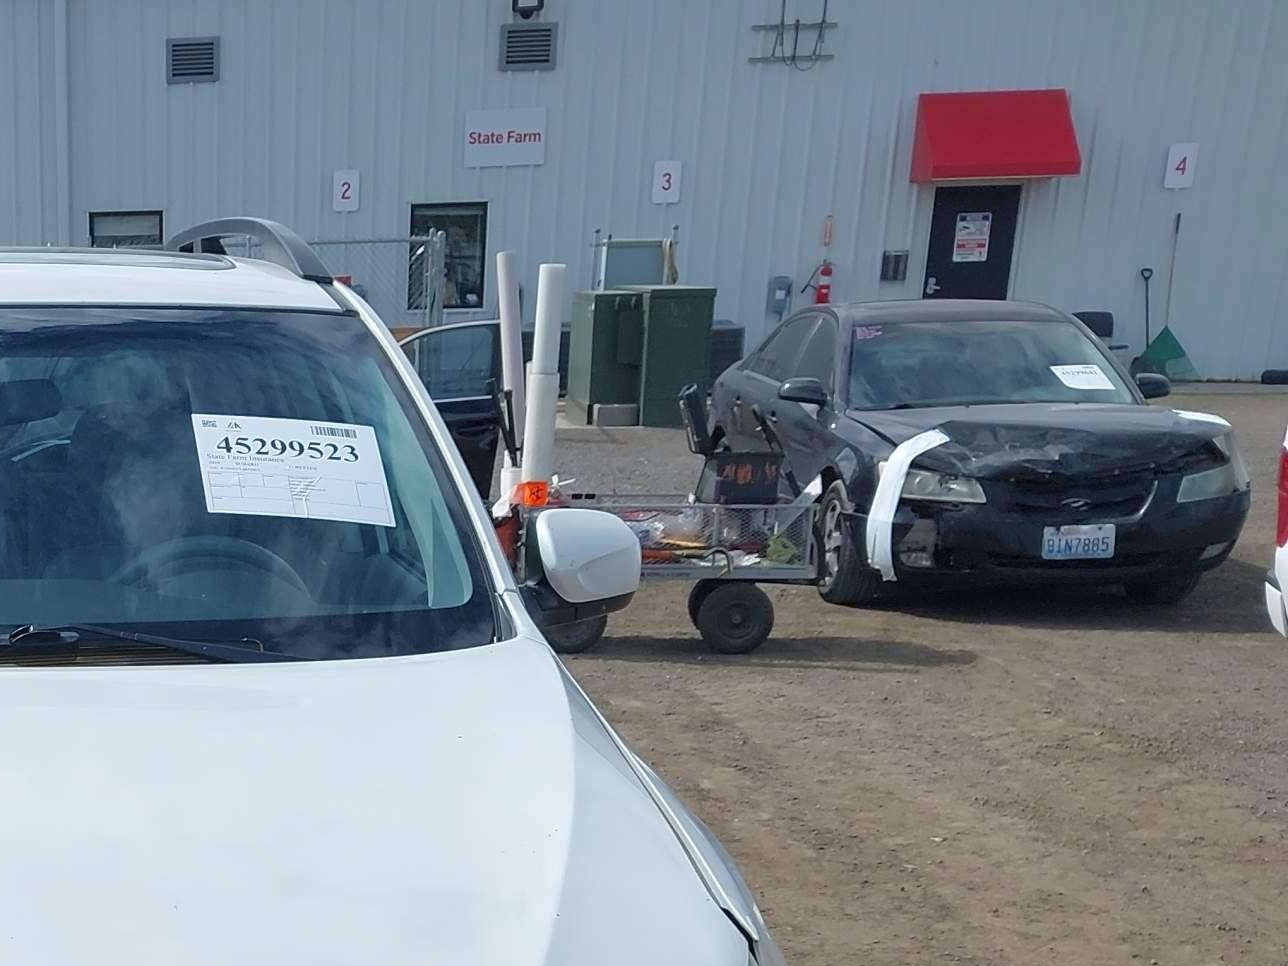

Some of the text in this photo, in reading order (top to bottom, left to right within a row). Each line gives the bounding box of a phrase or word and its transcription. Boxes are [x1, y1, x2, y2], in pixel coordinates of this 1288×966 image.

[468, 130, 542, 145] State Farm
[1175, 156, 1187, 176] 4
[341, 181, 352, 200] 2
[662, 172, 672, 191] 3
[216, 435, 359, 463] 45299523
